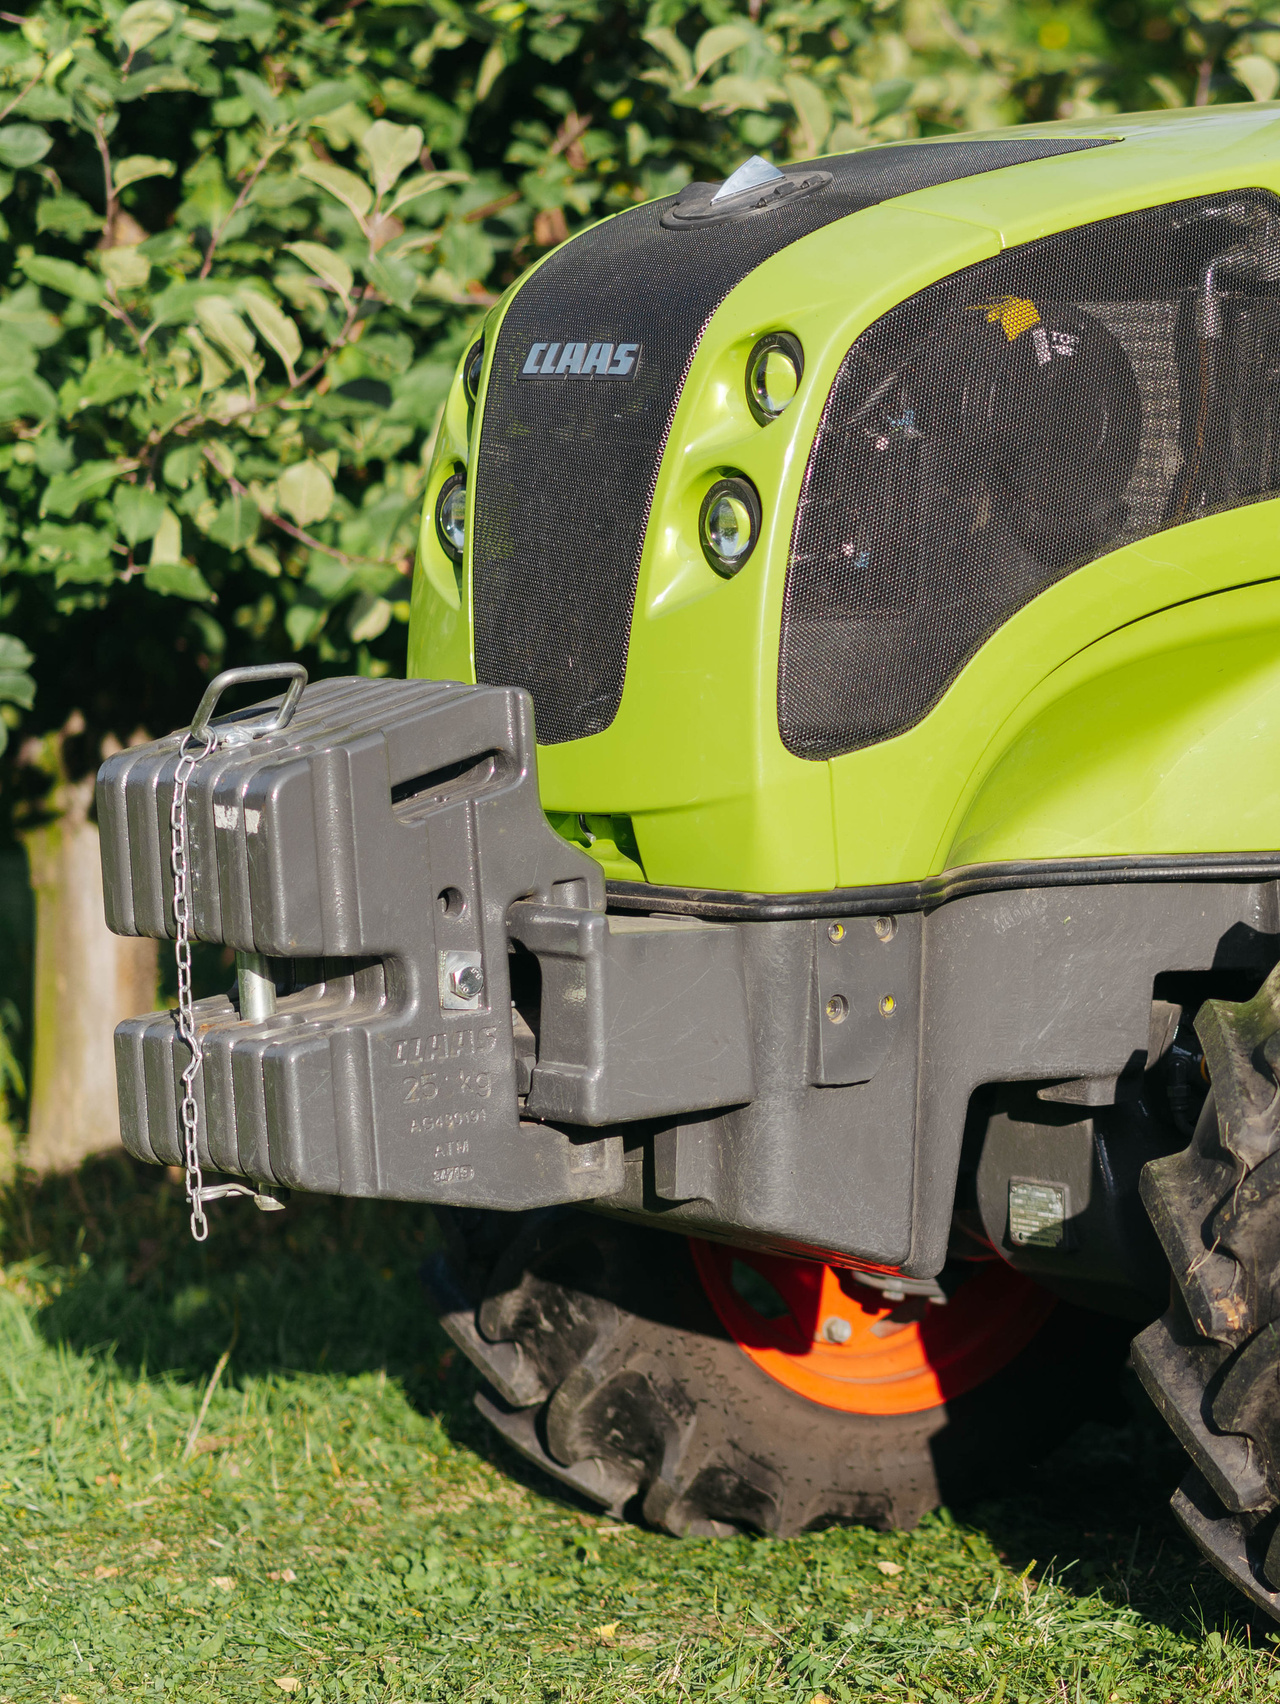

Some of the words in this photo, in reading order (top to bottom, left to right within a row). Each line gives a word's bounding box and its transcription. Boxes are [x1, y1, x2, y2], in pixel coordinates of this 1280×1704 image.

[522, 342, 640, 375] CLAAS
[391, 1026, 498, 1068] CLAAS
[403, 1073, 439, 1104] 25
[459, 1069, 493, 1100] kg
